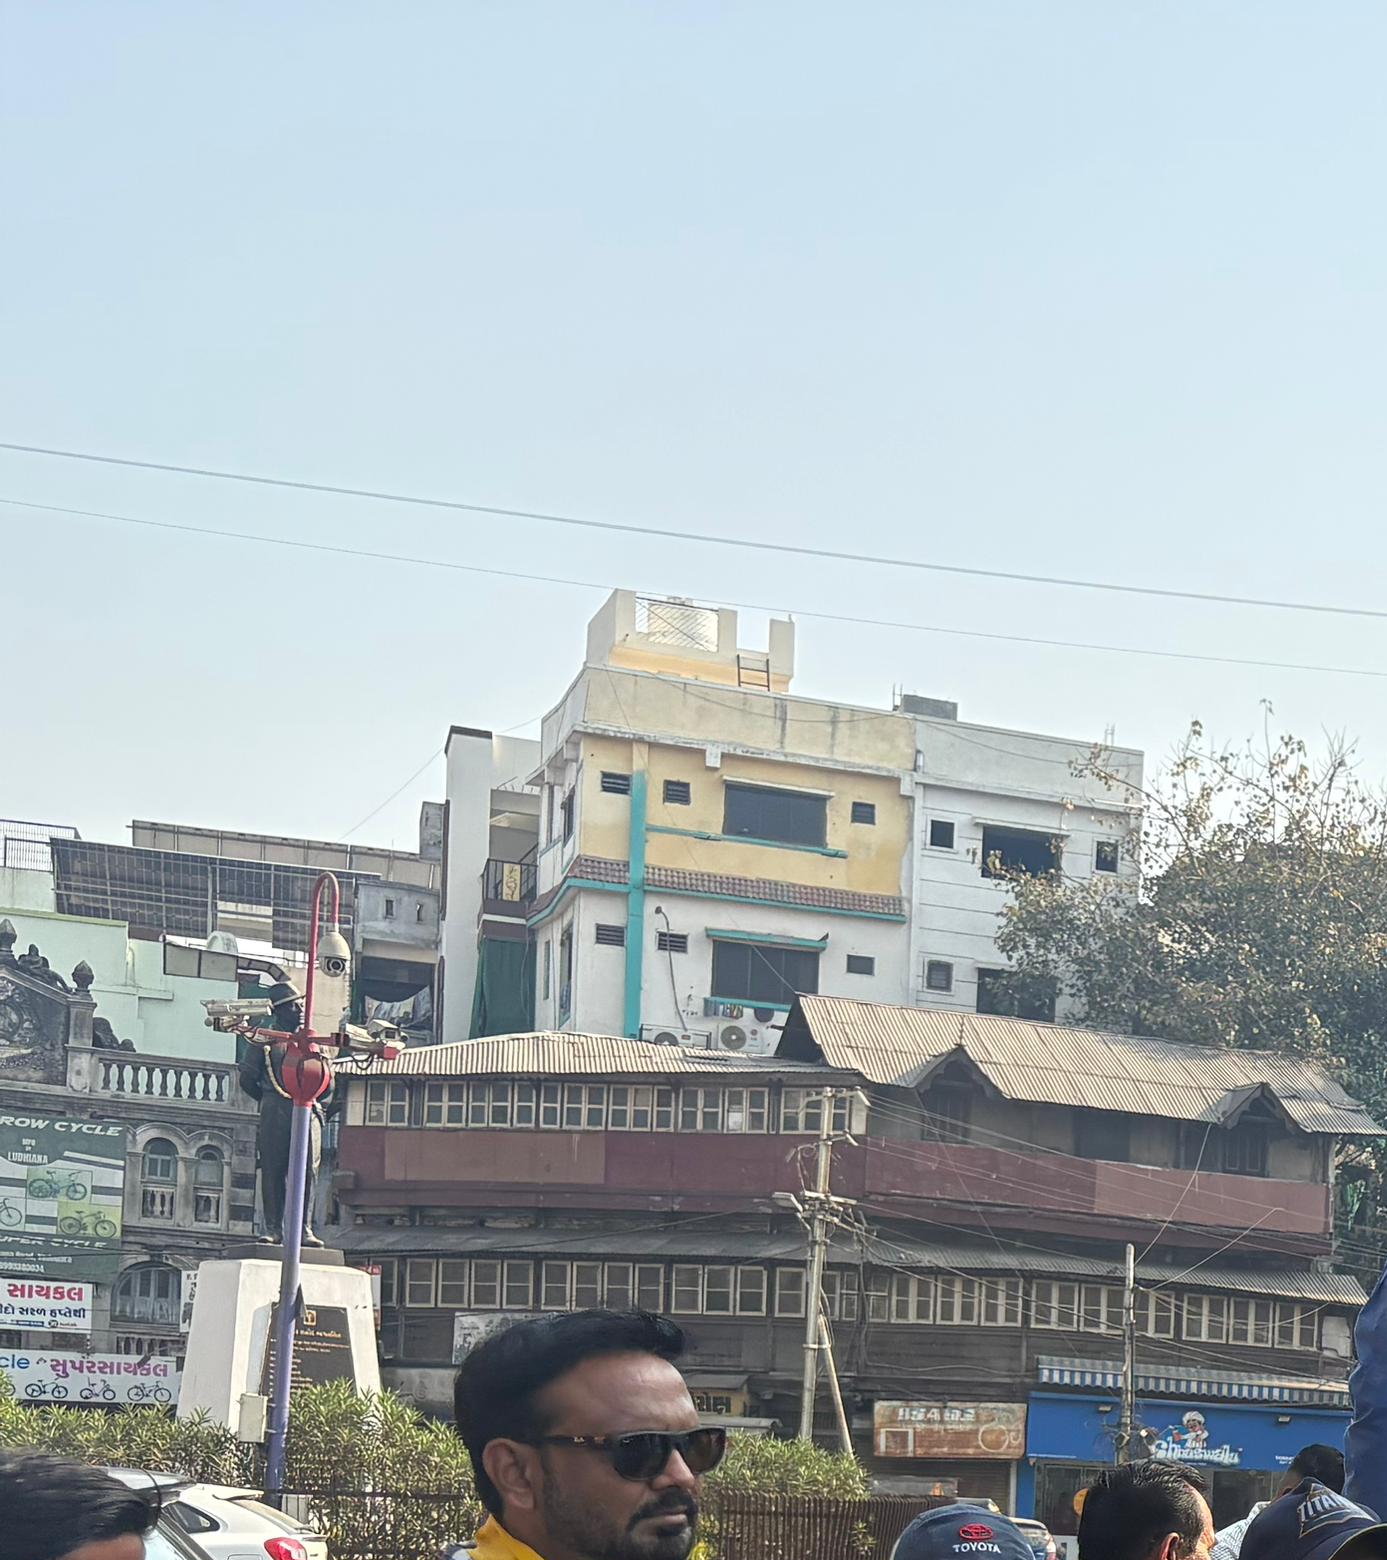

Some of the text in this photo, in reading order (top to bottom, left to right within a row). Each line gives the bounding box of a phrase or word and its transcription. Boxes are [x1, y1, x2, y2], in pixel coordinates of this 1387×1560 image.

[54, 1122, 123, 1136] CYCLE
[7, 1283, 83, 1301] સાયકલ
[952, 1542, 1002, 1554] TOYOTA
